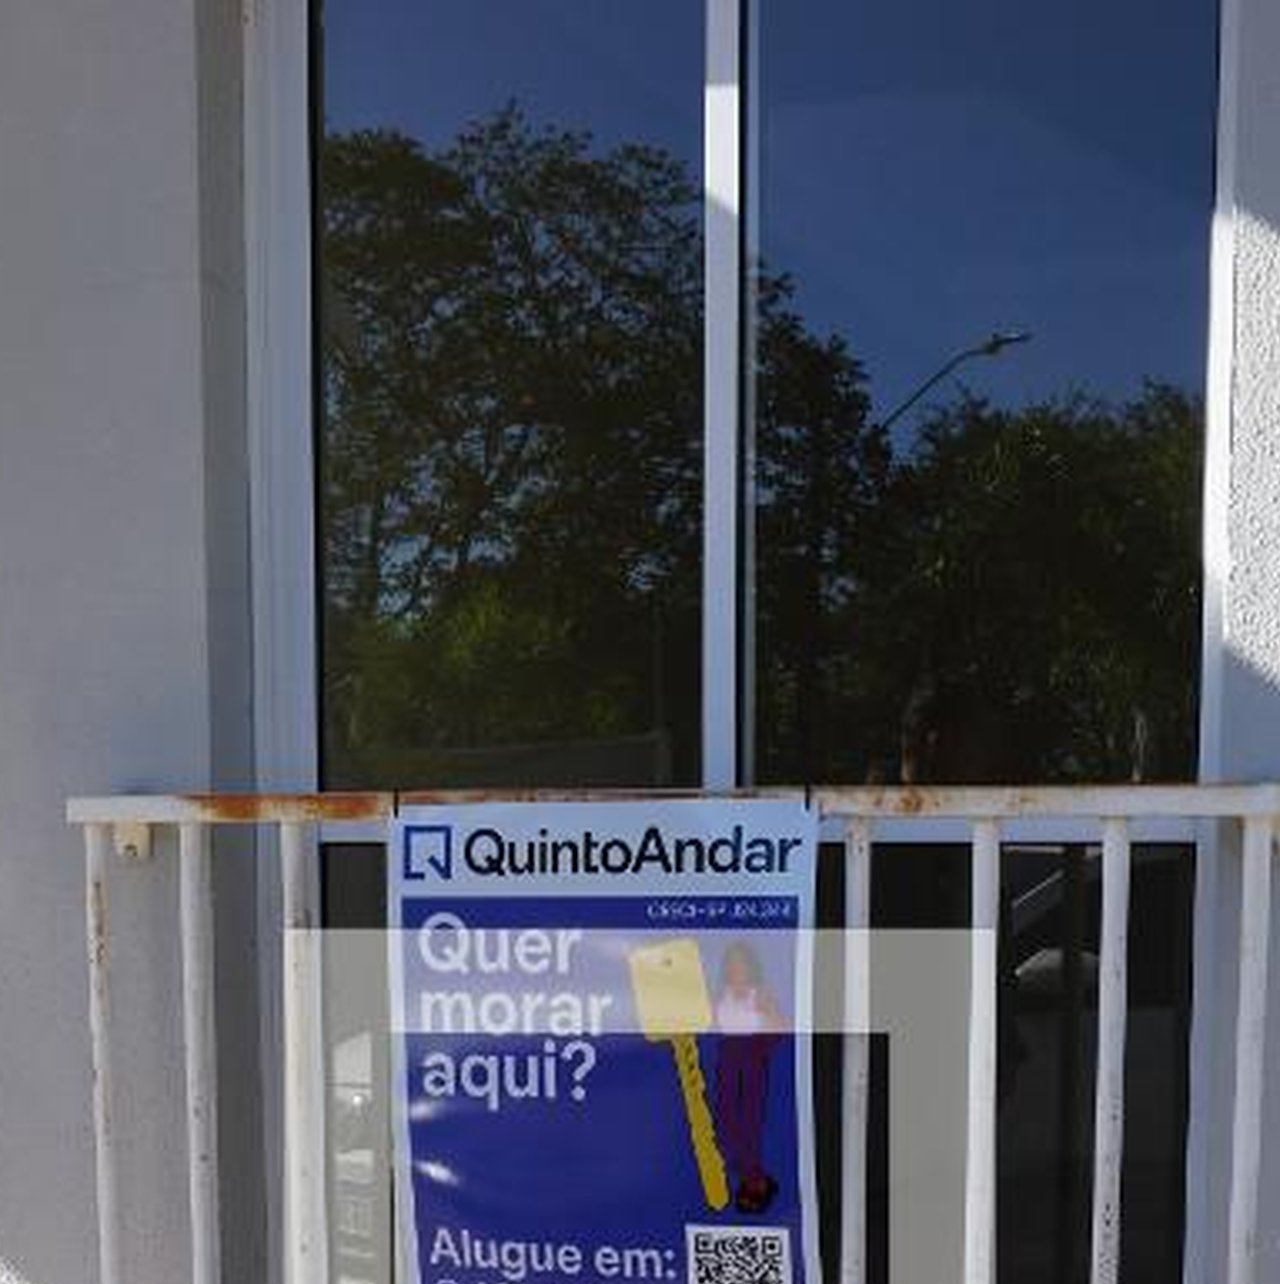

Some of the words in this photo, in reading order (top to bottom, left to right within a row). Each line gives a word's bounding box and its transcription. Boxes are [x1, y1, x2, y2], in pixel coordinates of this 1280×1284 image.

[463, 825, 803, 877] QuintoAndar
[418, 912, 582, 975] Quer
[420, 988, 614, 1036] morar
[422, 1039, 598, 1110] aqui?
[429, 1227, 583, 1281] Alugue
[593, 1245, 677, 1279] em:
